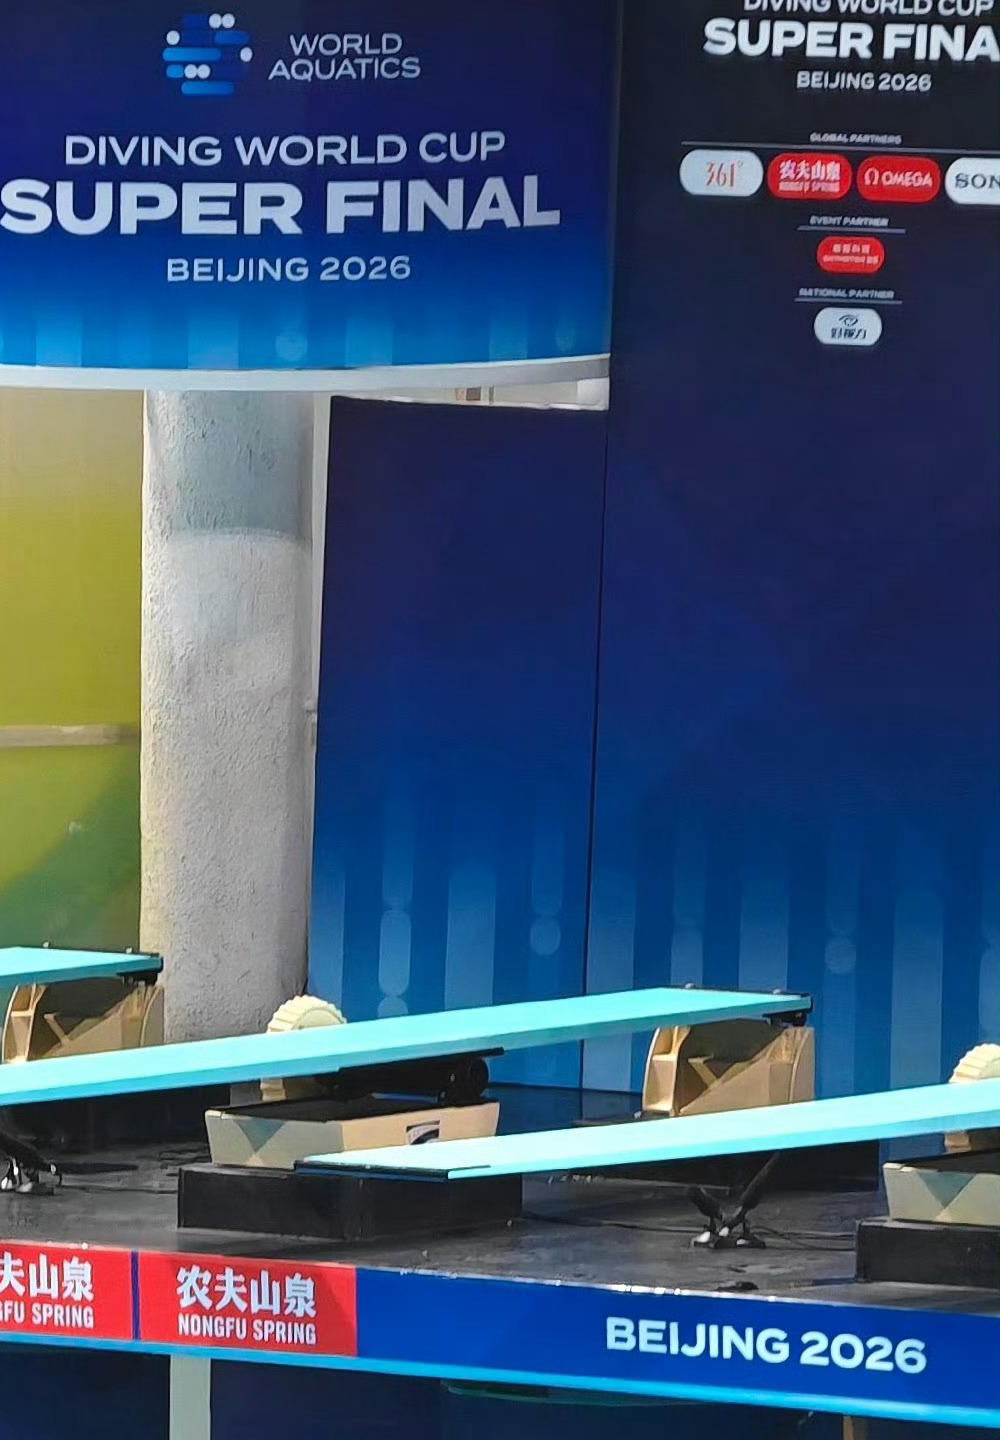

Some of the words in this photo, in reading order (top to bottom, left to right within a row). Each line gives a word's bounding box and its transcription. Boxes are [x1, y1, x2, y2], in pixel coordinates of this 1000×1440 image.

[289, 33, 402, 56] WORLD
[703, 18, 873, 58] SUPER
[268, 56, 421, 81] AQUATICS
[796, 70, 874, 90] BEIJING
[878, 73, 932, 92] 2026
[65, 134, 221, 166] DIVING
[235, 133, 406, 166] WORLD
[419, 131, 506, 162] CUP
[882, 171, 933, 187] OMEGA
[0, 179, 303, 236] SUPER
[326, 175, 561, 235] FINAL
[166, 257, 309, 282] BEIJING
[319, 255, 411, 281] 2026
[176, 1264, 316, 1318] 农夫山泉
[31, 1304, 95, 1329] SPRING
[178, 1312, 247, 1341] NONGFU
[252, 1319, 317, 1345] SPRING
[606, 1316, 790, 1364] BEIJING
[800, 1331, 927, 1374] 2026
